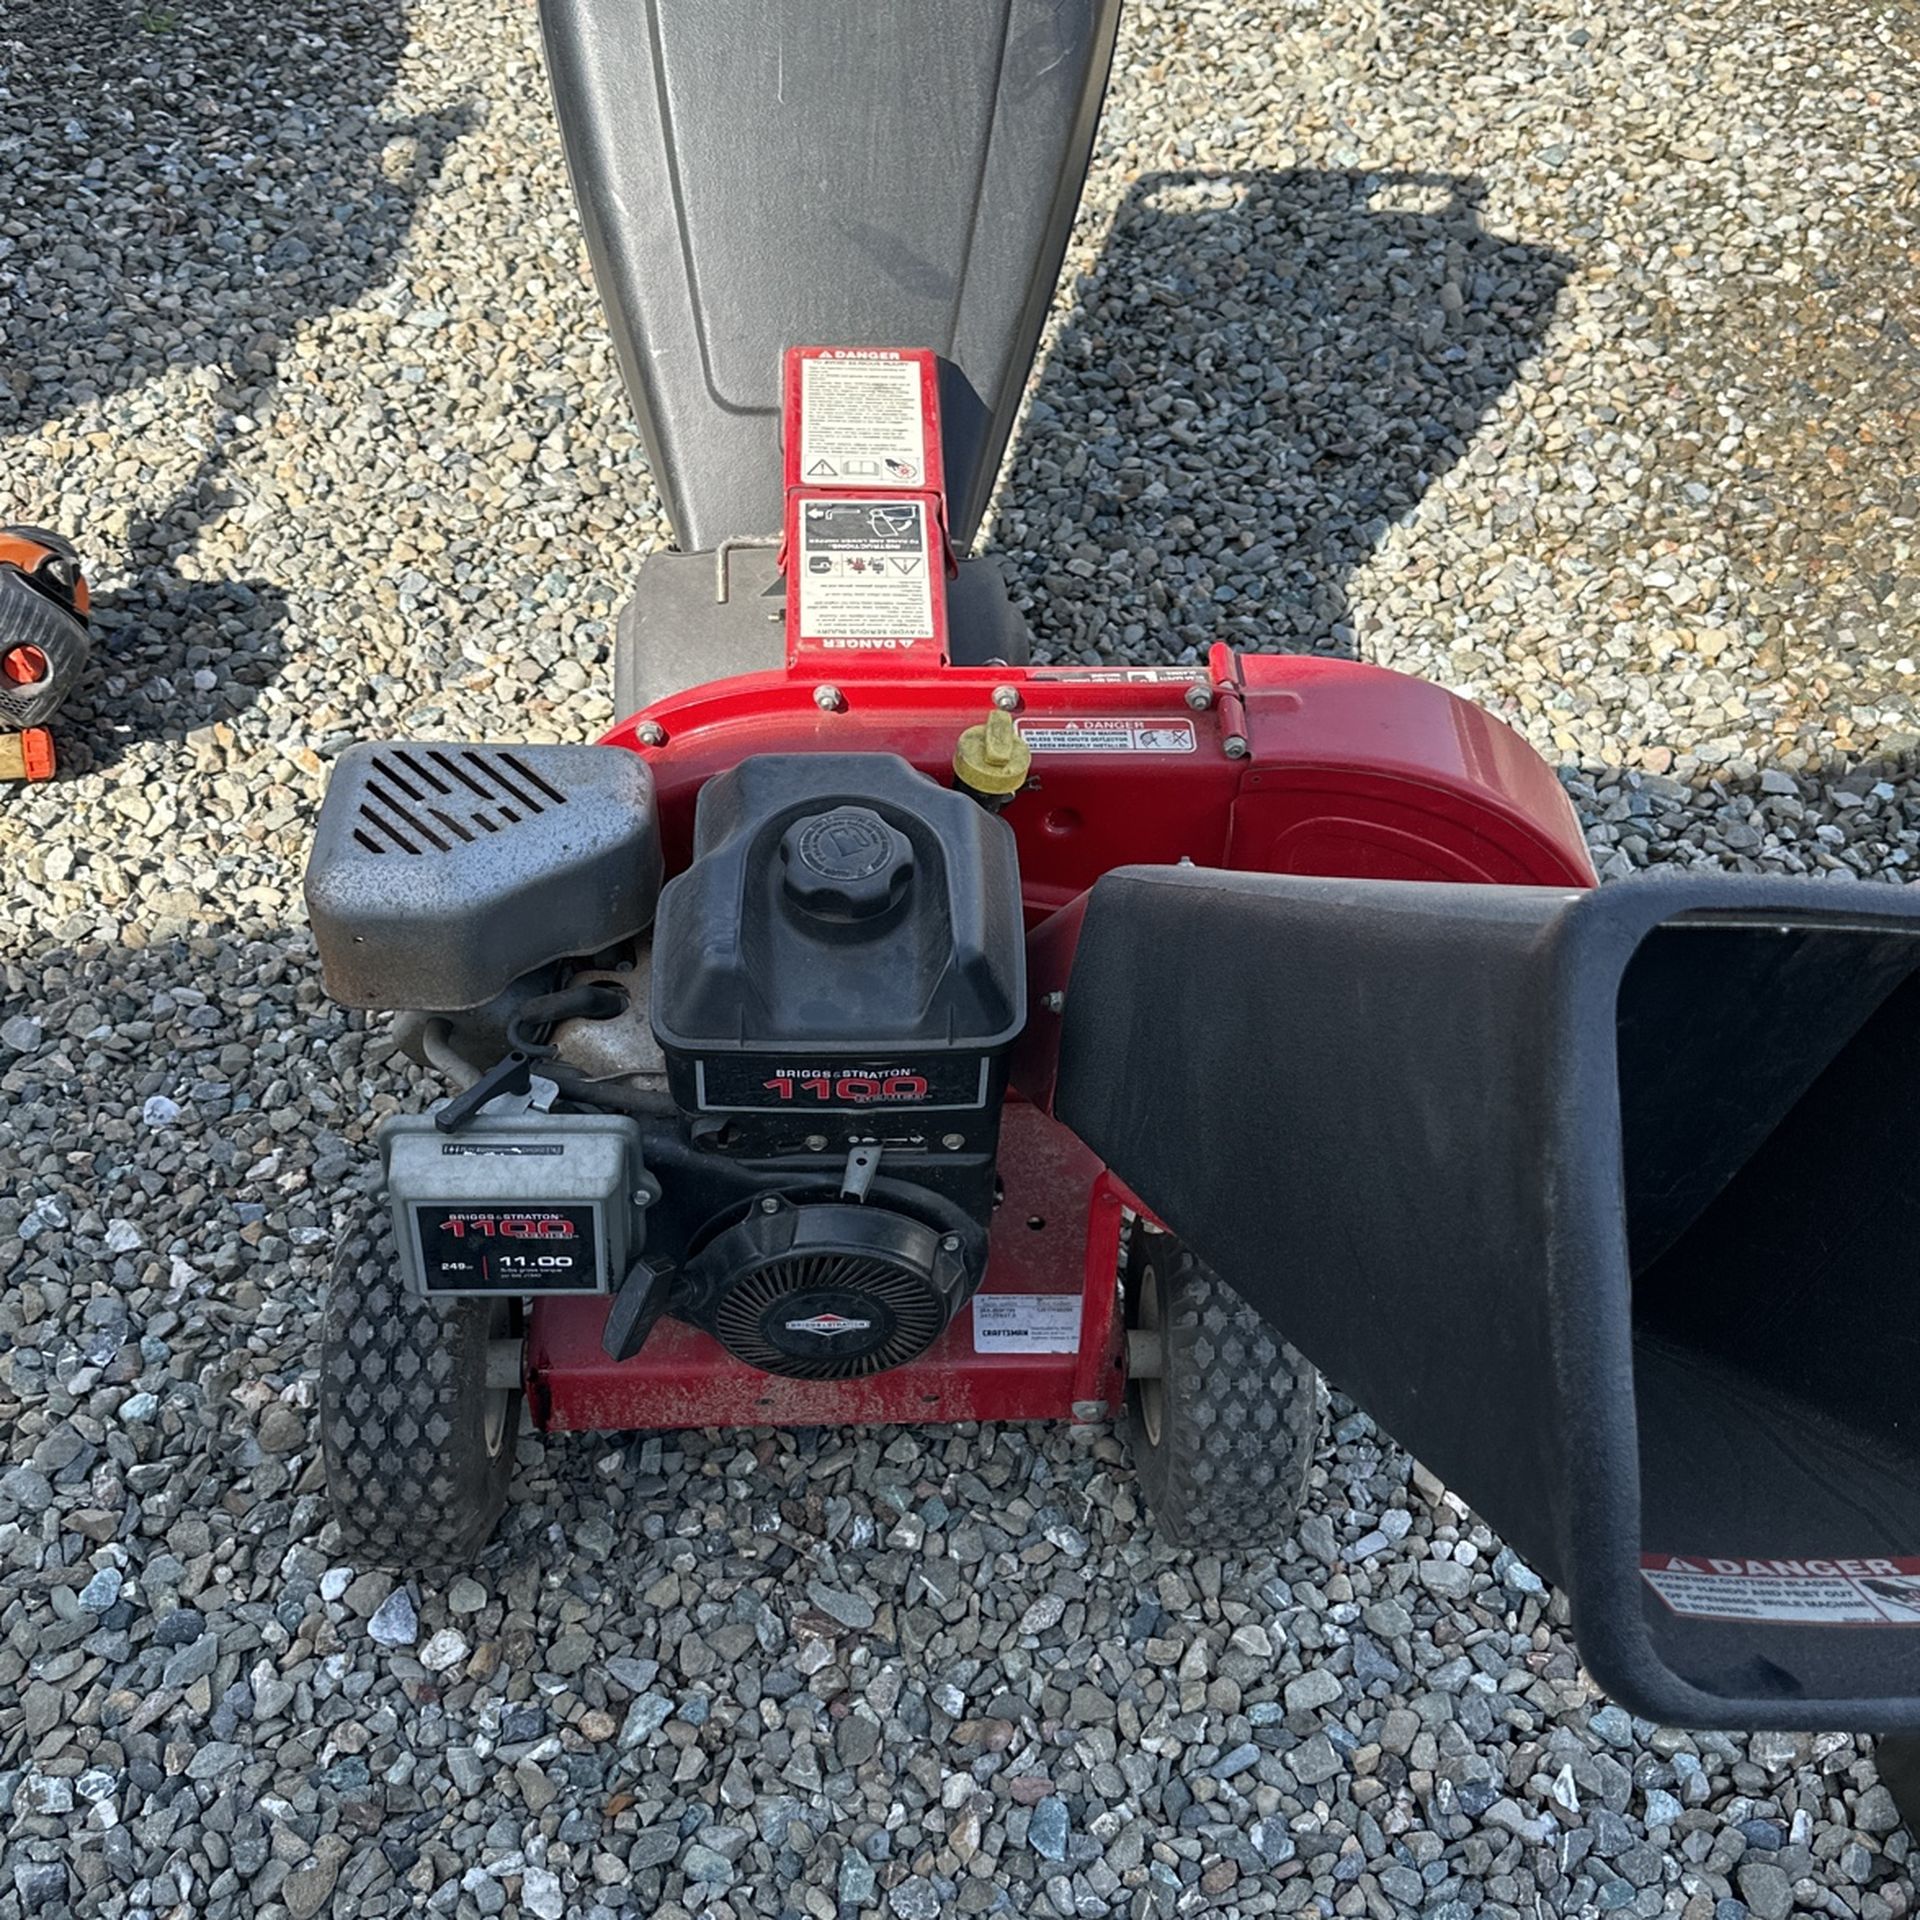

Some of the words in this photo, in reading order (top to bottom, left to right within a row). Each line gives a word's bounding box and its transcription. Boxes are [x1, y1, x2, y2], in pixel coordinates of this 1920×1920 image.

[834, 351, 900, 360] DANGER
[822, 639, 897, 649] DANGER
[1083, 721, 1145, 729] DANGER
[776, 1069, 833, 1078] BRIGGS
[842, 1068, 911, 1079] STRATTON
[763, 1076, 928, 1100] 1100
[439, 1220, 574, 1237] 1100
[499, 1256, 573, 1267] 11.00
[982, 1329, 1029, 1337] CRAFTSMAN
[1708, 1558, 1902, 1577] DANGER
[1646, 1572, 1717, 1584] ROTATING
[1718, 1578, 1783, 1587] CUTTING
[1655, 1582, 1693, 1591] KEEP
[1696, 1586, 1748, 1596] HANDS
[1751, 1589, 1782, 1597] AND
[1783, 1590, 1821, 1598] FEET
[1824, 1590, 1854, 1598] OUT
[1664, 1591, 1682, 1599] OF
[1687, 1594, 1758, 1606] OPENINGS
[1759, 1600, 1805, 1608] WHILE
[1806, 1600, 1869, 1609] MACHINE
[1674, 1602, 1689, 1610] IS
